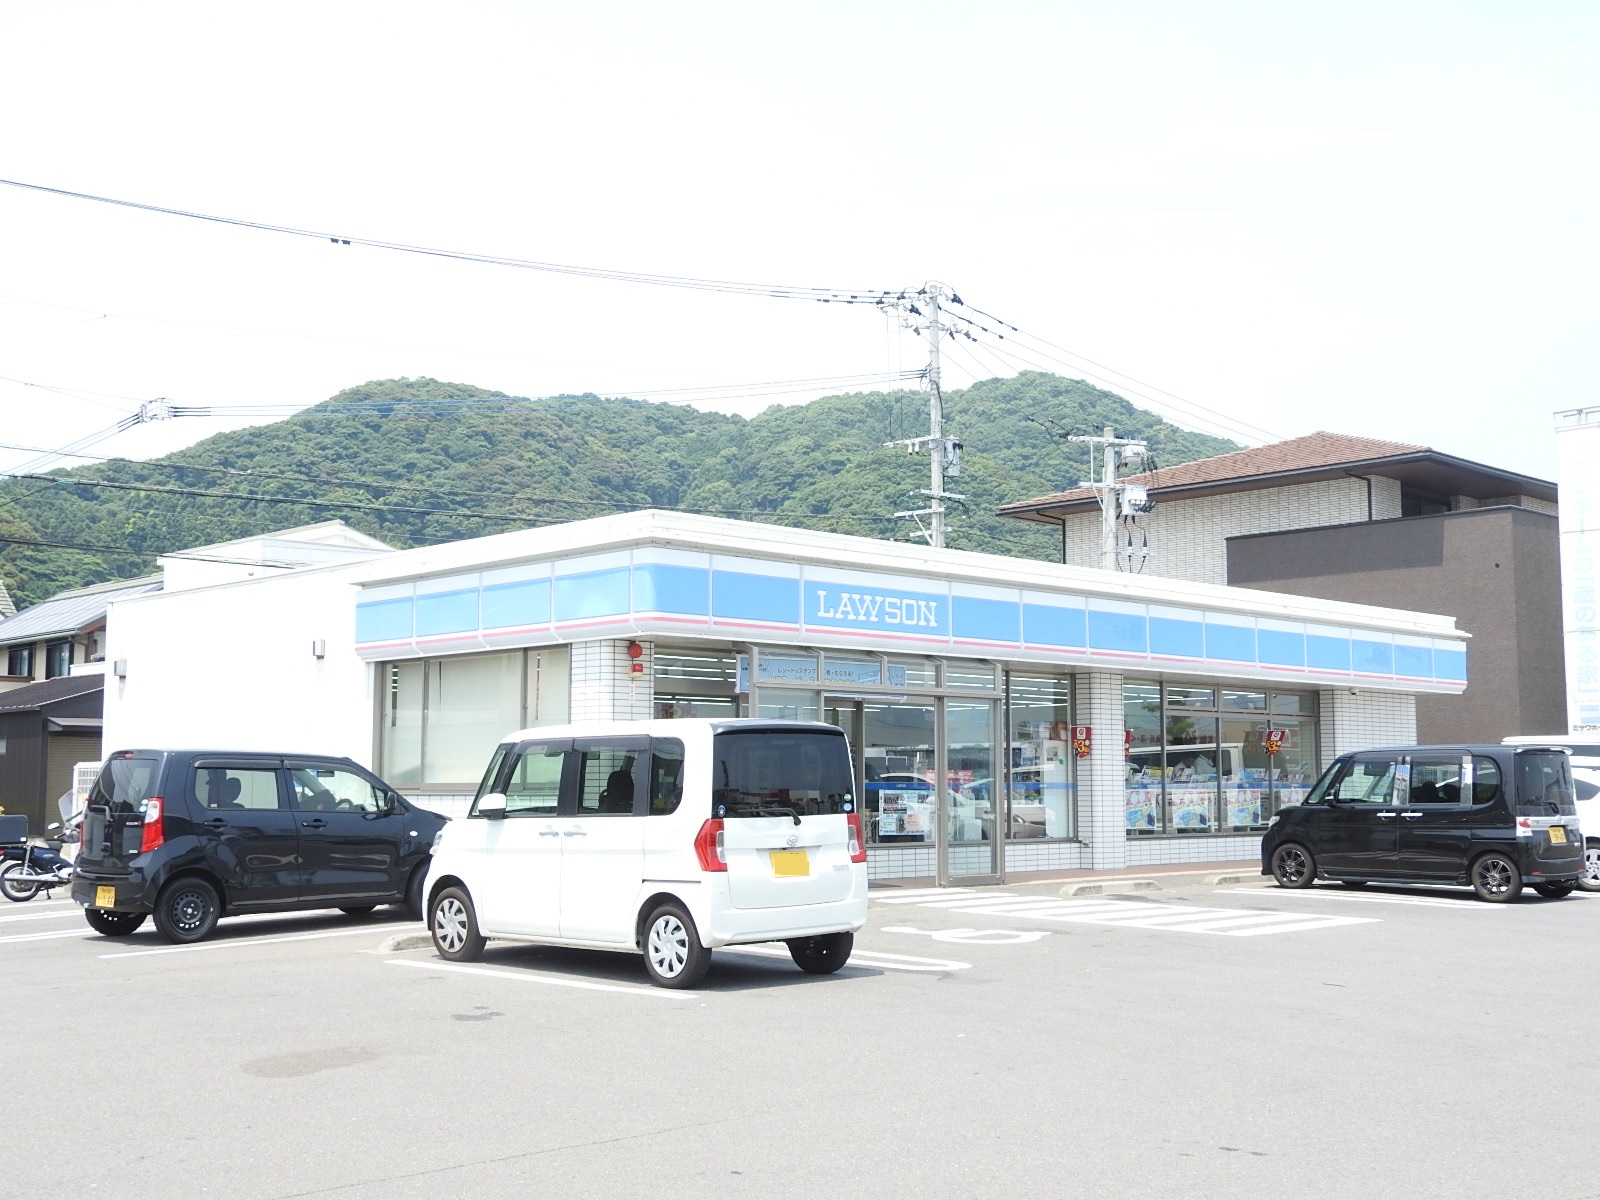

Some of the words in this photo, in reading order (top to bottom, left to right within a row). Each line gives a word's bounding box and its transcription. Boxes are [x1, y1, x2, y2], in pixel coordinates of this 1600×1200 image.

[817, 590, 938, 627] LAWSON
[1567, 442, 1599, 692] ワホームの「蔵のある家」
